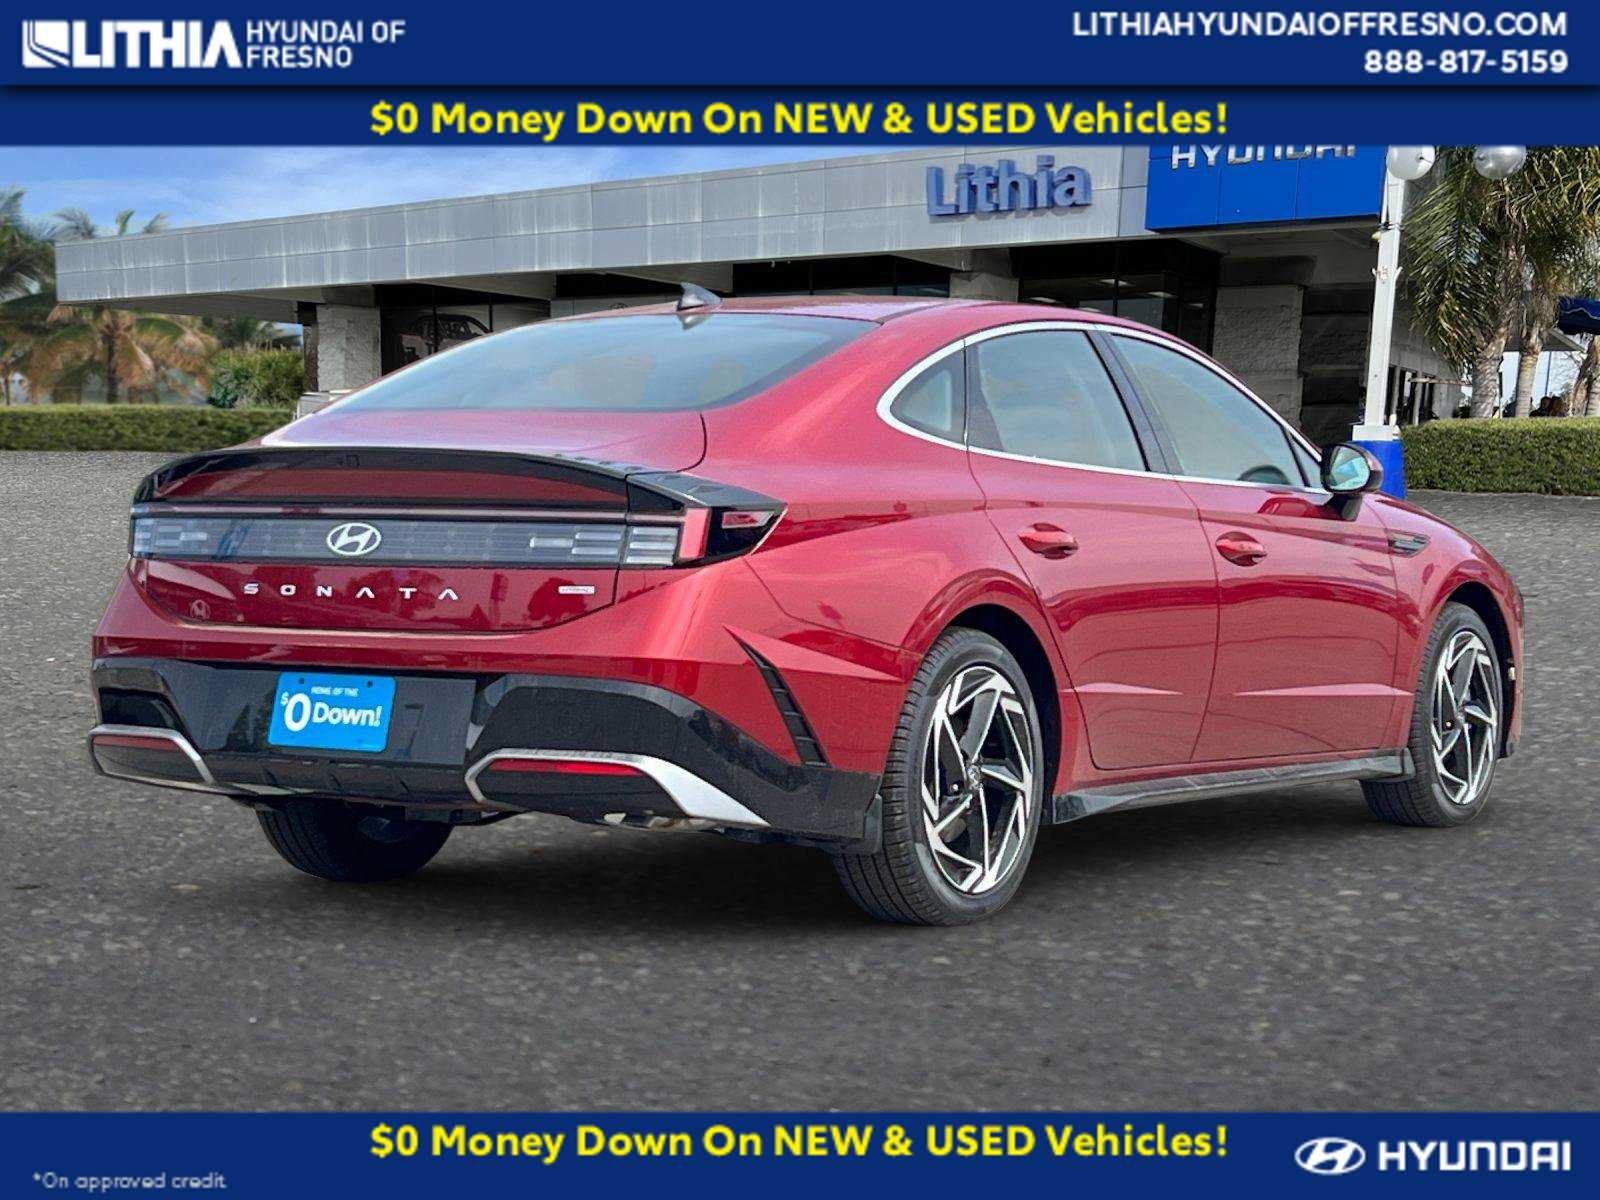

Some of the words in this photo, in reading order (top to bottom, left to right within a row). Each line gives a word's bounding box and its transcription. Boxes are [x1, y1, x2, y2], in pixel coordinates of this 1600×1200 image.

[926, 155, 1092, 216] Lithia
[243, 583, 460, 601] SONATA
[312, 701, 382, 727] Down!
